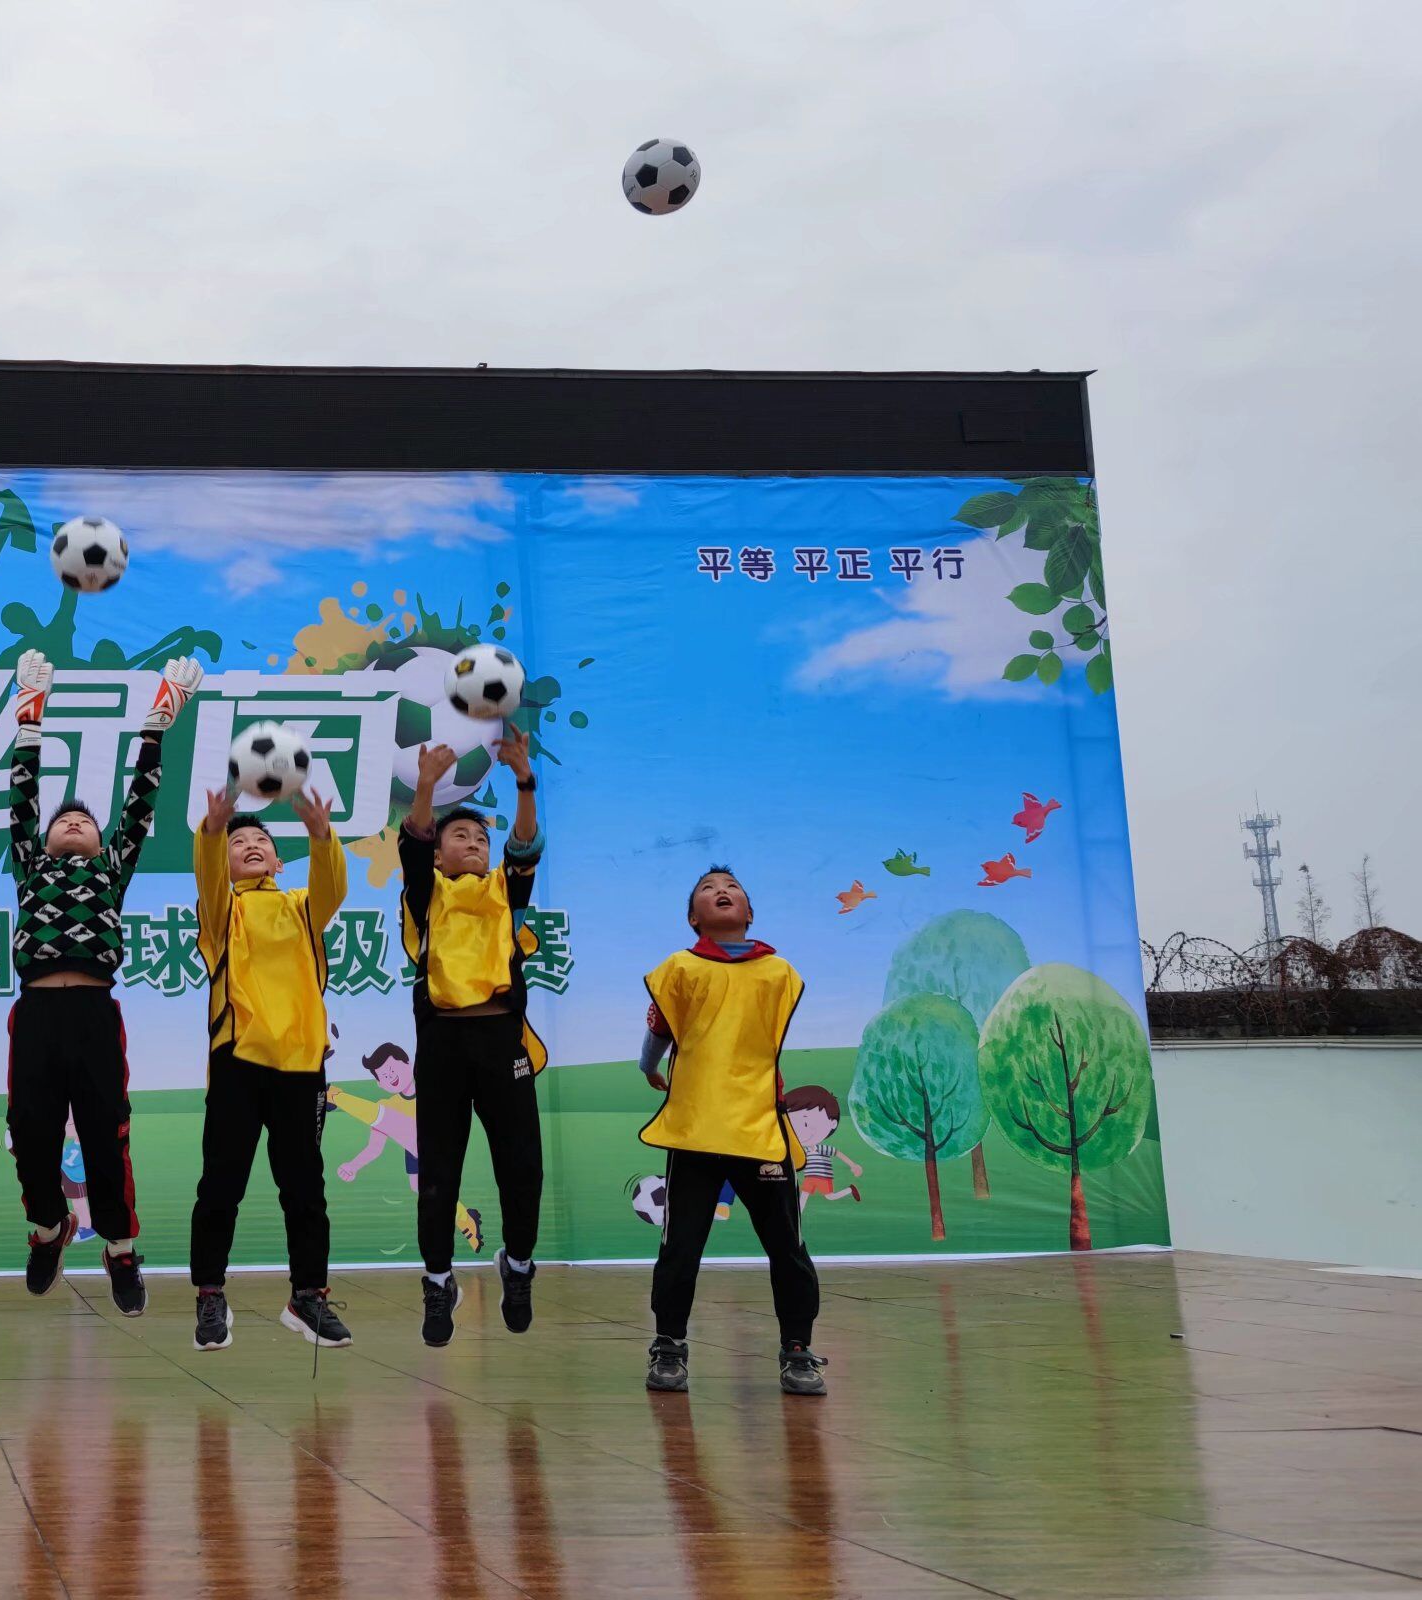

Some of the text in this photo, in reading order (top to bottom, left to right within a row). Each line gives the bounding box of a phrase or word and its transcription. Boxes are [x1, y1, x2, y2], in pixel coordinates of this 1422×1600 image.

[697, 546, 965, 582] 平等 平正 平行
